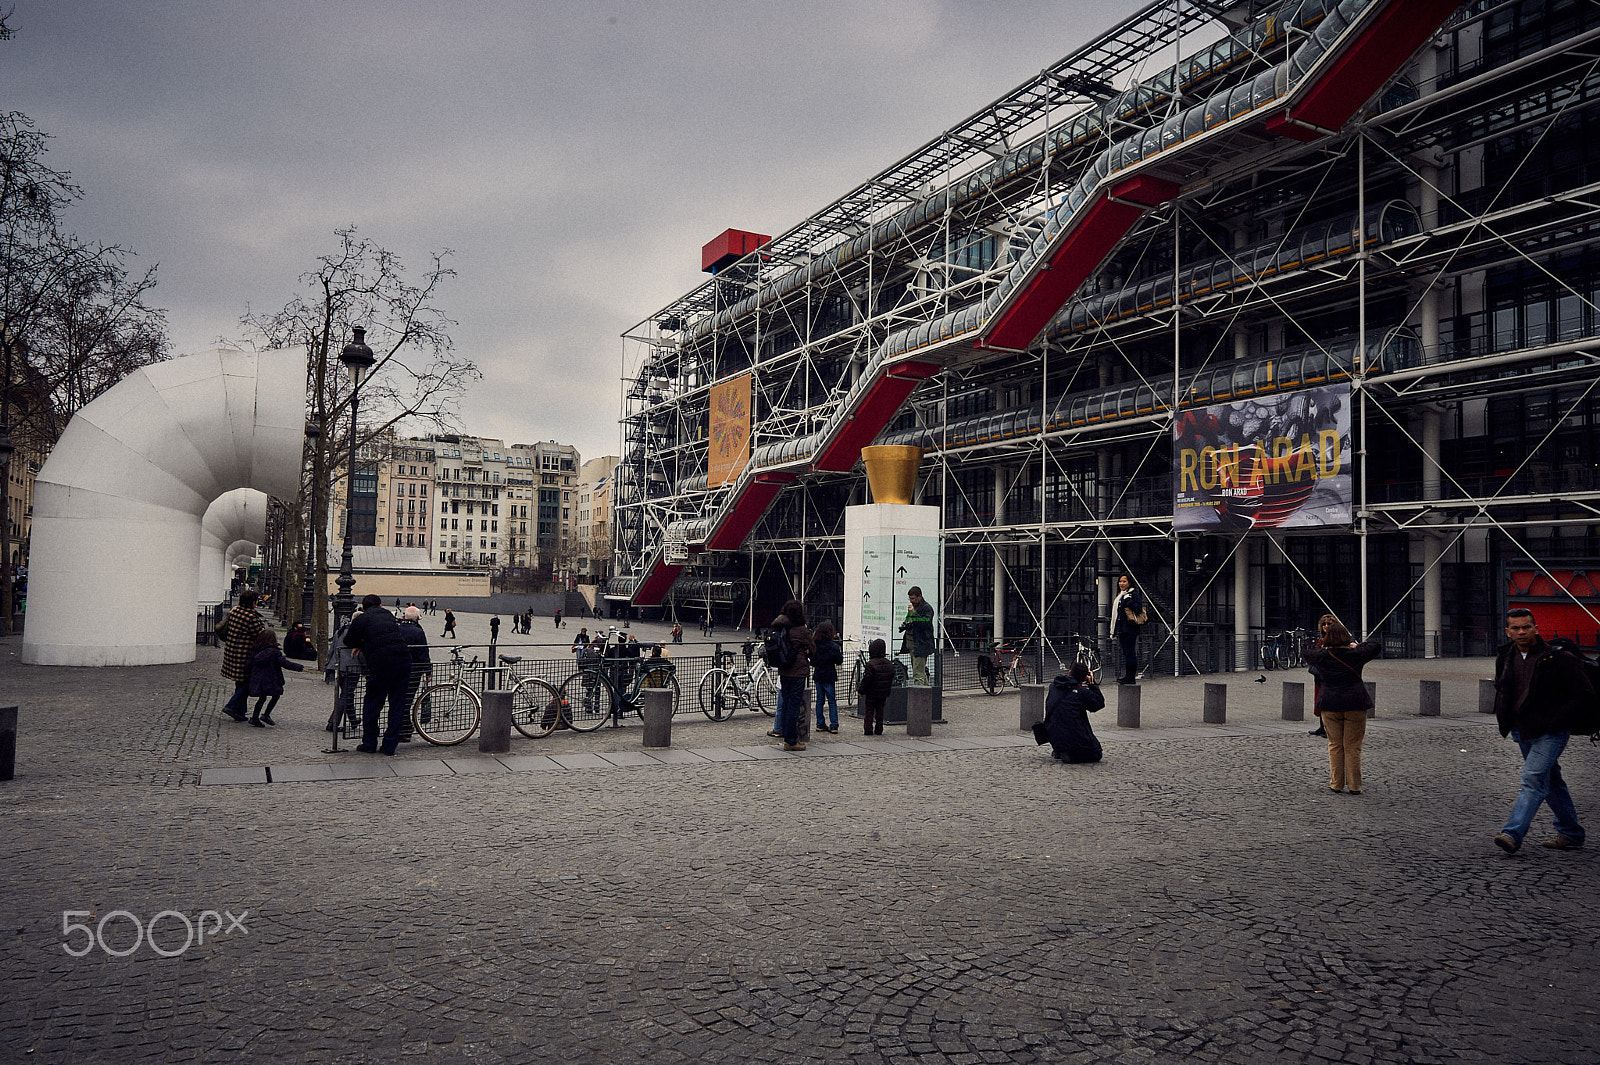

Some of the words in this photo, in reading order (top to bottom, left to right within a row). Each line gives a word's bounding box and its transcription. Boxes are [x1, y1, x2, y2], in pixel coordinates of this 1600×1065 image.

[1180, 442, 1240, 492] RON
[1249, 429, 1341, 486] ARAD
[1221, 488, 1233, 497] RON
[1234, 487, 1248, 496] ARAD
